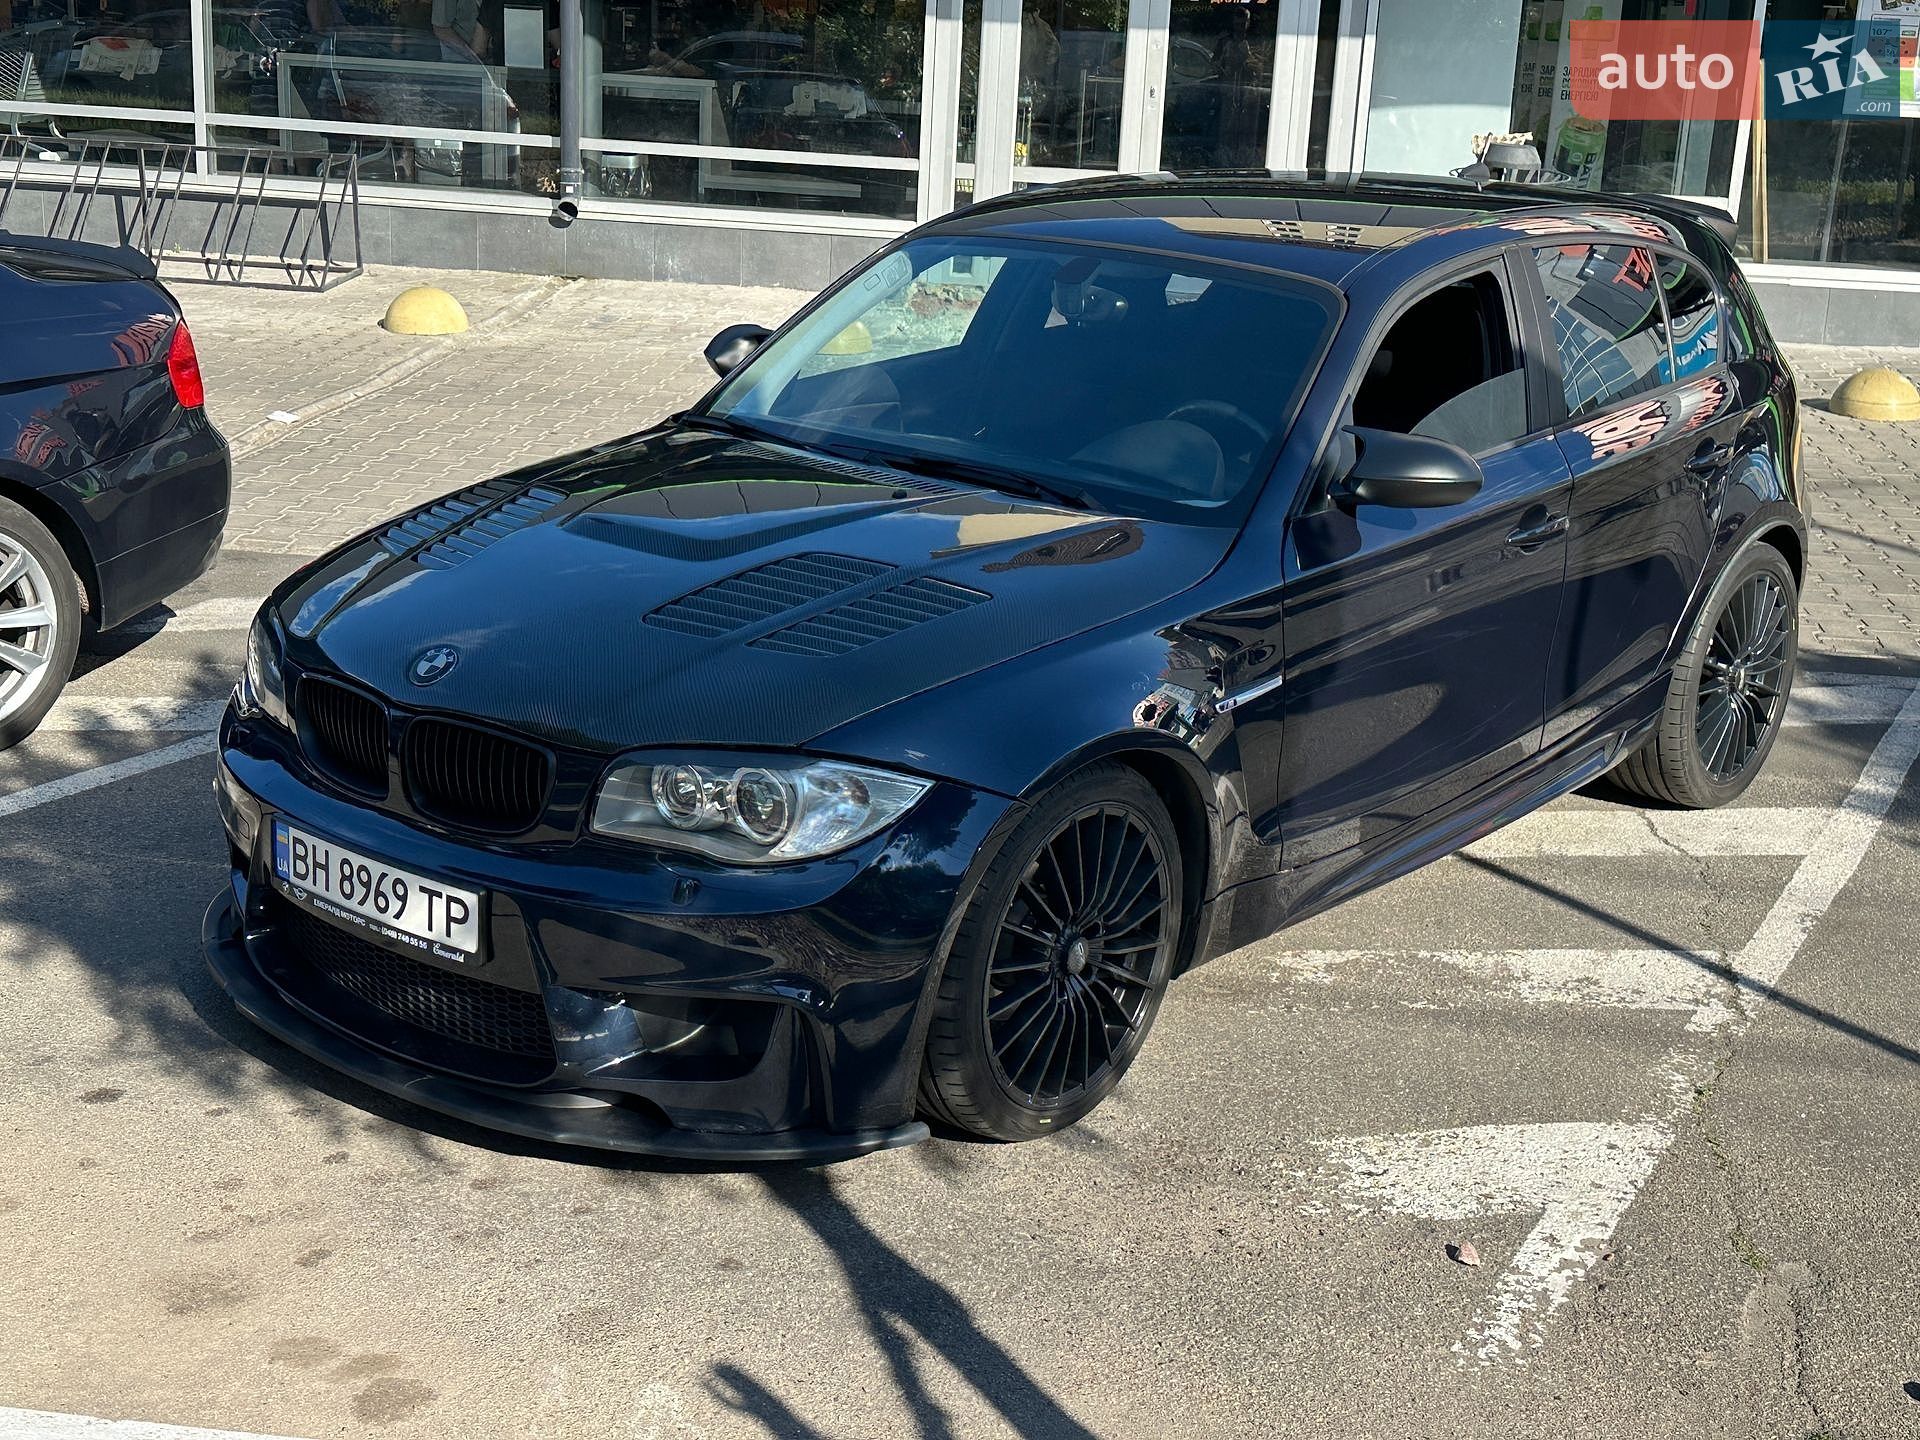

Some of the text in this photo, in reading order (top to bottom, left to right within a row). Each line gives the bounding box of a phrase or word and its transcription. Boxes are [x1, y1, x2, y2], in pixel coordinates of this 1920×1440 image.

[276, 857, 289, 873] UA
[292, 836, 470, 939] BH 8969 TP
